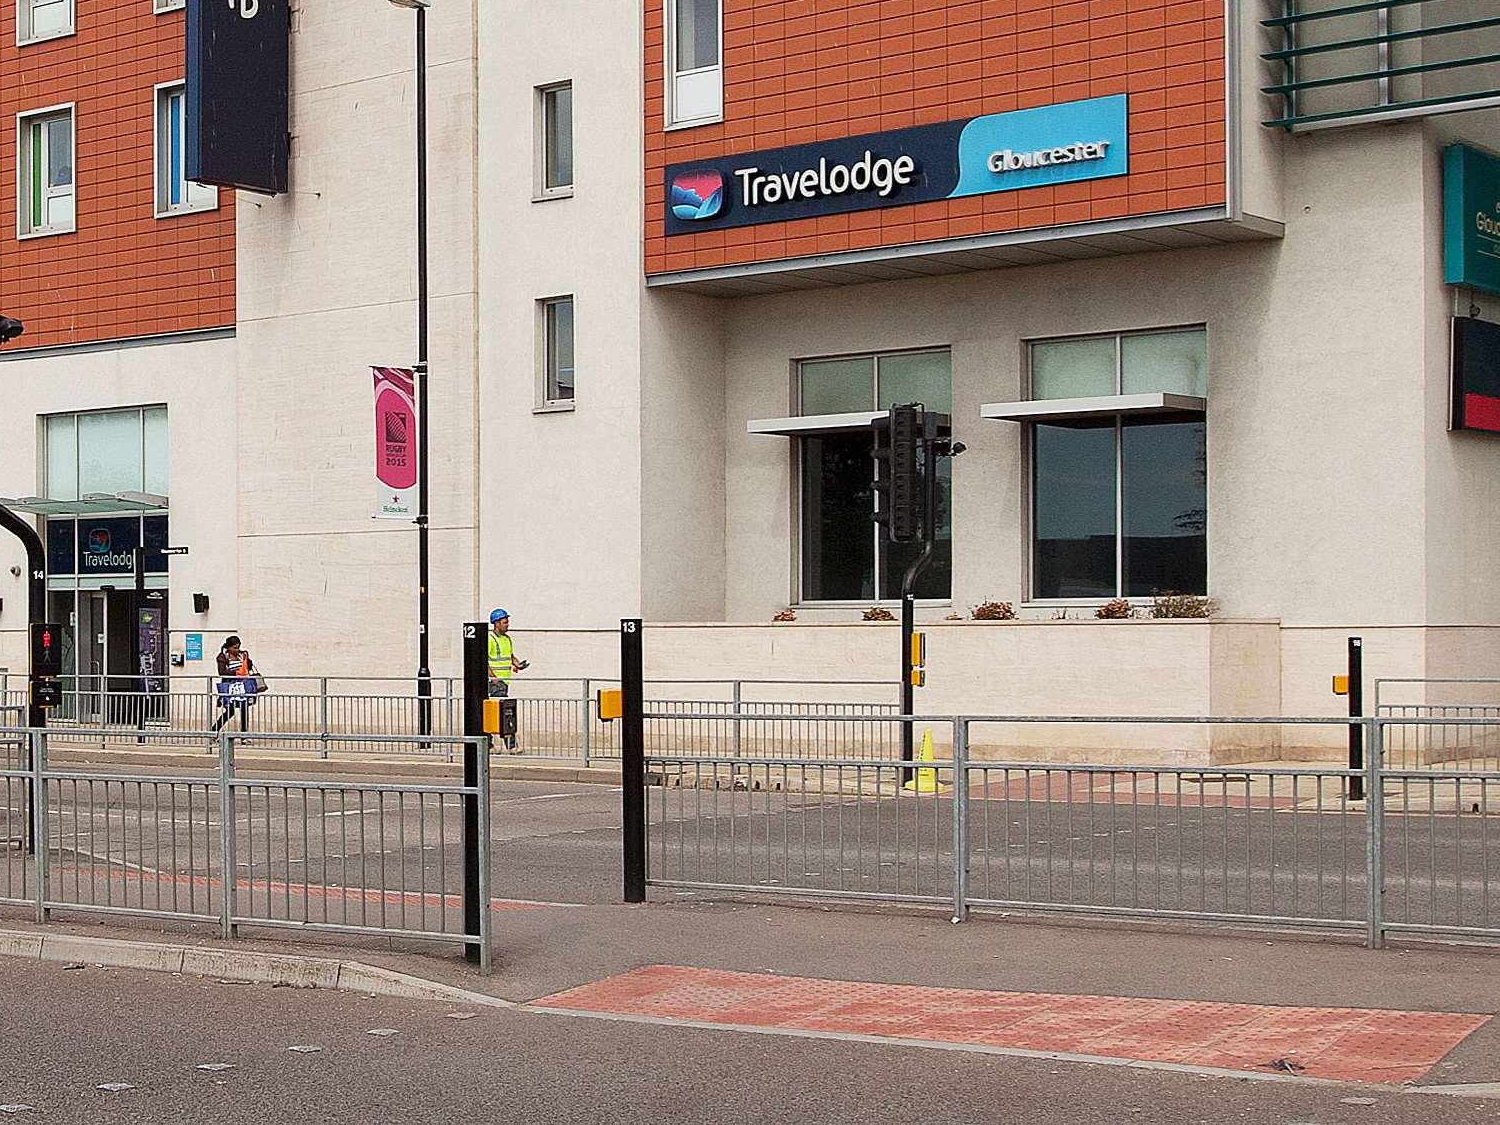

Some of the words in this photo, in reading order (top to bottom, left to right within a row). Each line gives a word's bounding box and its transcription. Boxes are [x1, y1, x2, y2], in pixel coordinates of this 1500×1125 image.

[986, 138, 1111, 174] Gloucester
[734, 150, 915, 207] Travelodge
[385, 444, 407, 453] RUGBY
[385, 457, 407, 467] 2015
[82, 550, 133, 569] Travelodg
[33, 569, 44, 580] 14
[463, 625, 476, 639] 12
[622, 621, 636, 633] 13
